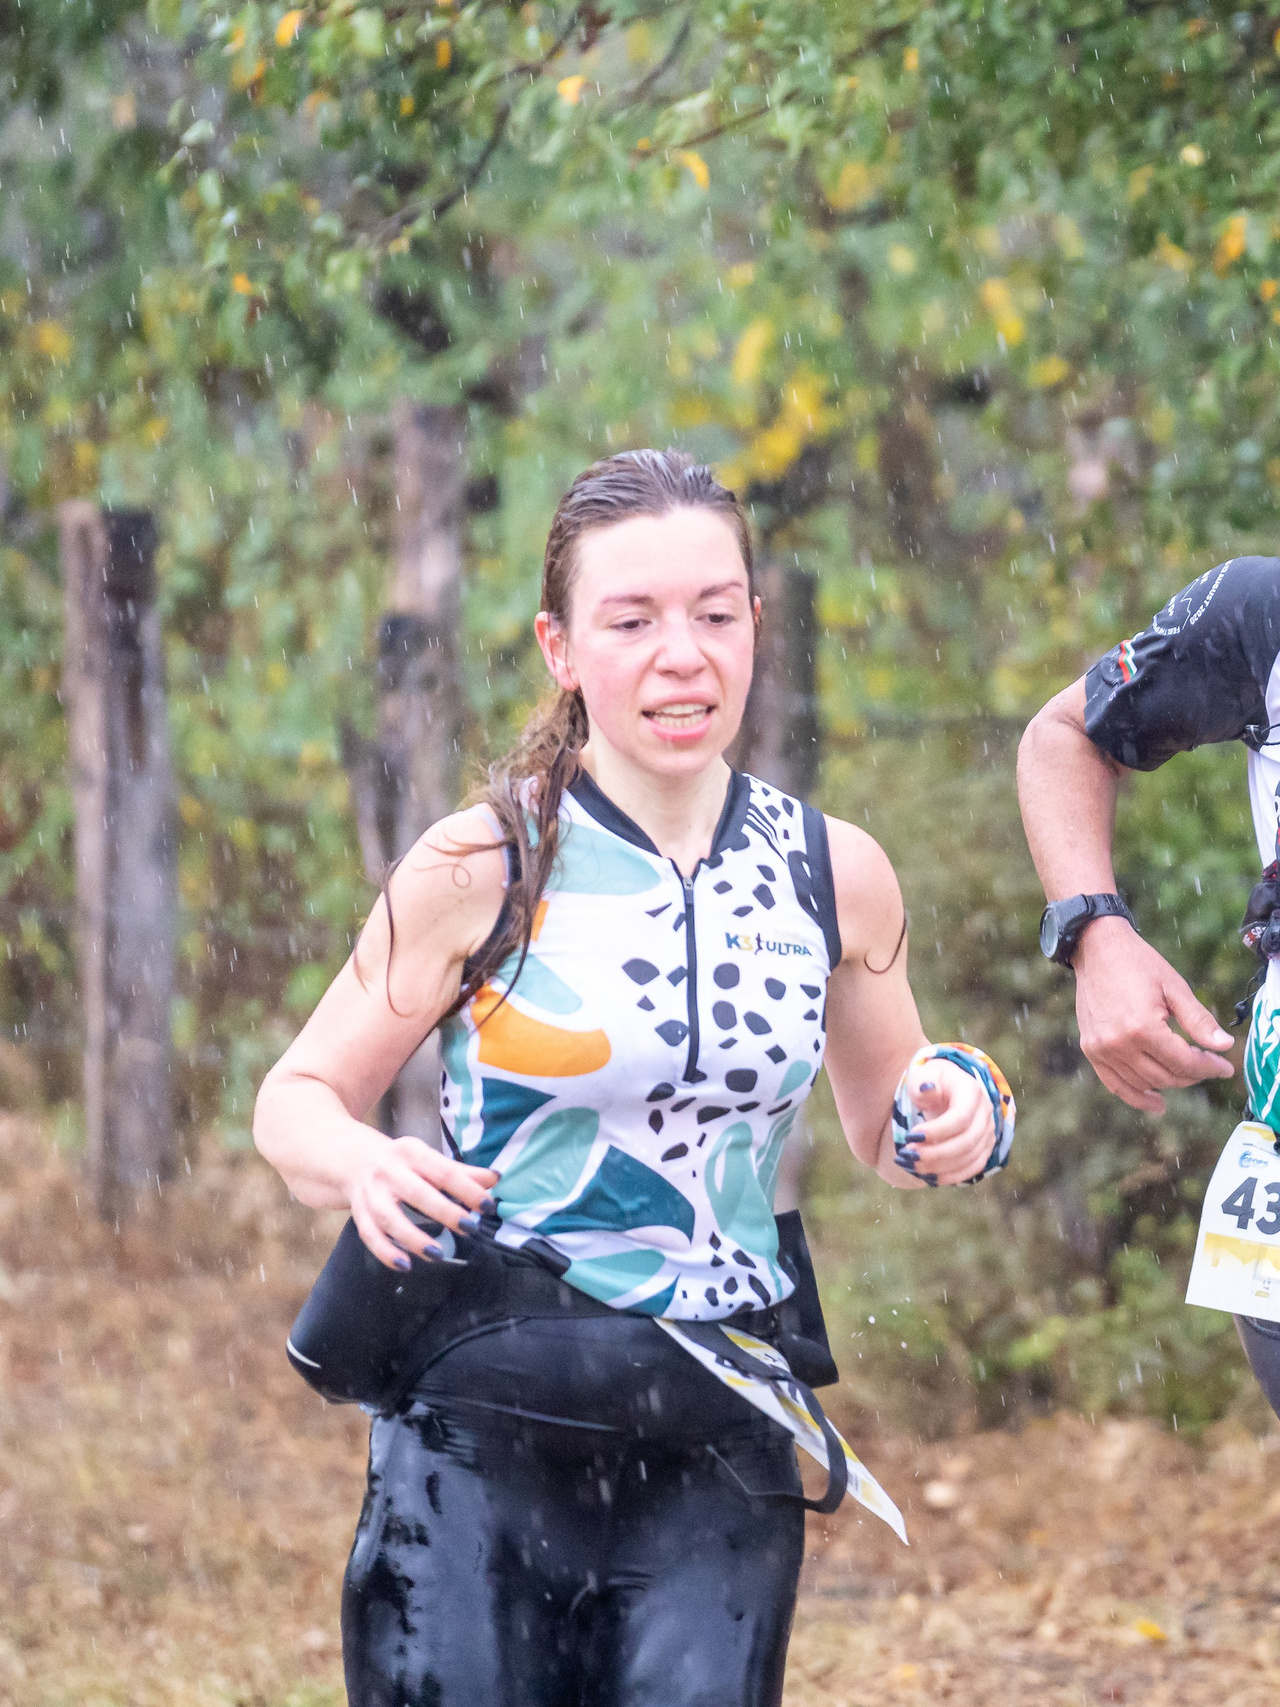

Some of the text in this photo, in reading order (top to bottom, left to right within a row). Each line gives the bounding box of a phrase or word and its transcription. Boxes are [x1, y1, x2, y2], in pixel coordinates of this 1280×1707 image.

[1204, 574, 1224, 607] AUGUST
[1190, 605, 1205, 625] 2020
[725, 932, 812, 957] K3 ULTRA
